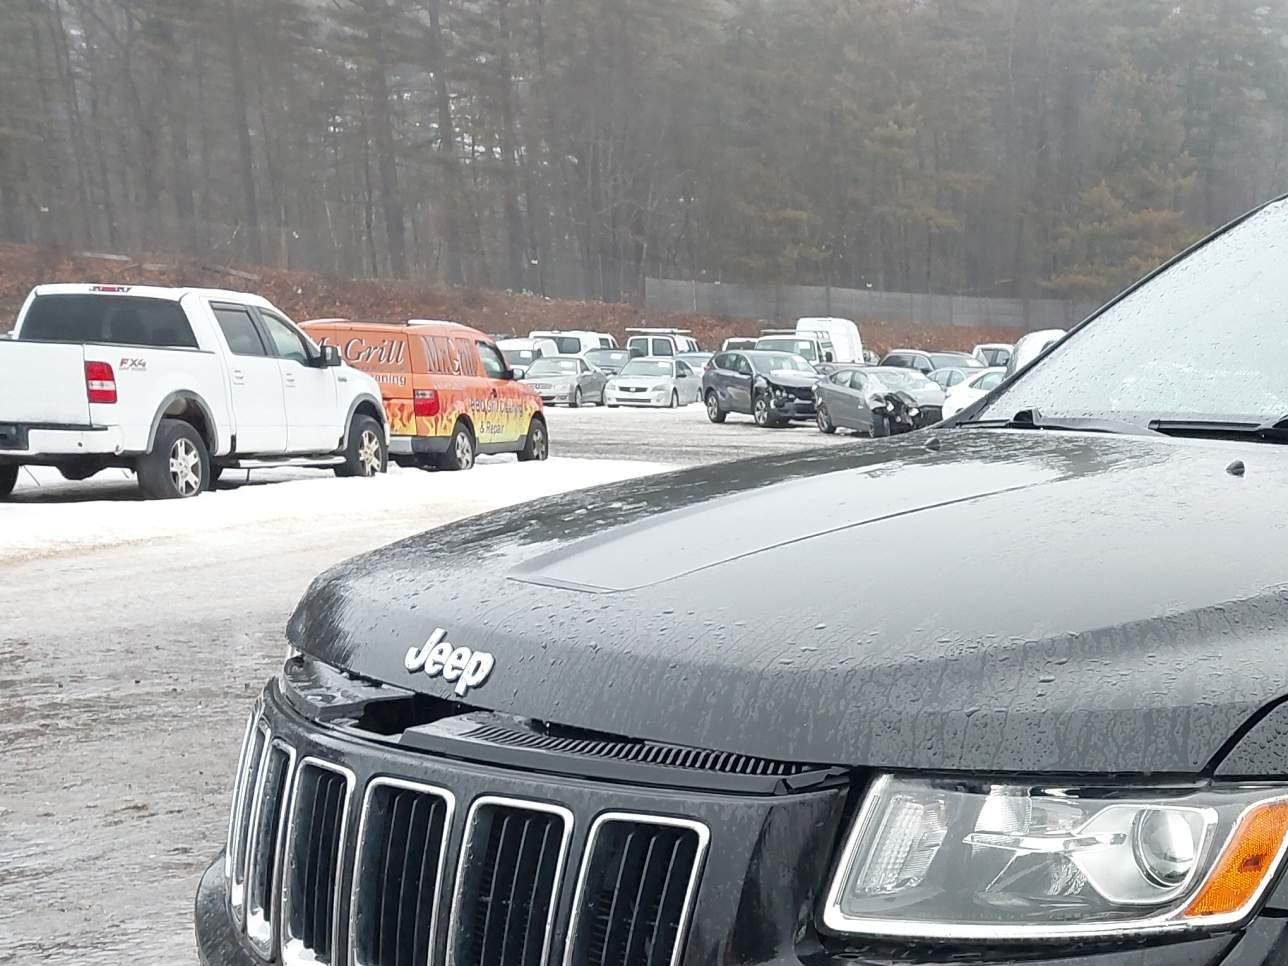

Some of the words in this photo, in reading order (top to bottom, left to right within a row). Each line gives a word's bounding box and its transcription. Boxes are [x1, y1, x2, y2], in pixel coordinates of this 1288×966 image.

[344, 337, 405, 365] Grill
[120, 358, 146, 367] FX4
[486, 421, 504, 436] Repair
[404, 626, 496, 698] Jeep
